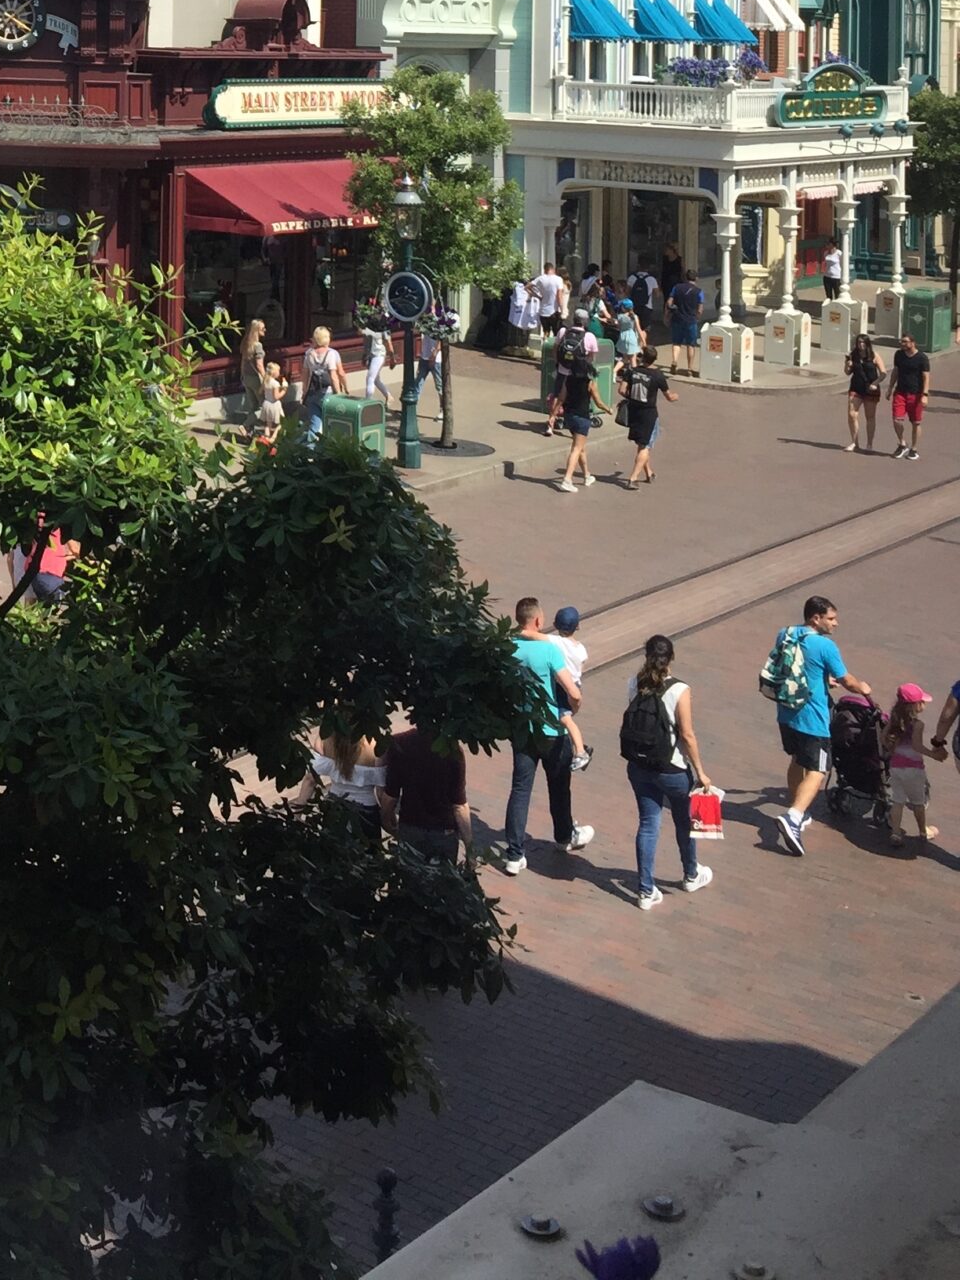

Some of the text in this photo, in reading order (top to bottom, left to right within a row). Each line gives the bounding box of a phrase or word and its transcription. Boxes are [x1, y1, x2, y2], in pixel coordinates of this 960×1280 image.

[241, 91, 280, 113] MAIN
[284, 90, 335, 112] STREET
[272, 217, 354, 233] DEPENDABLE
